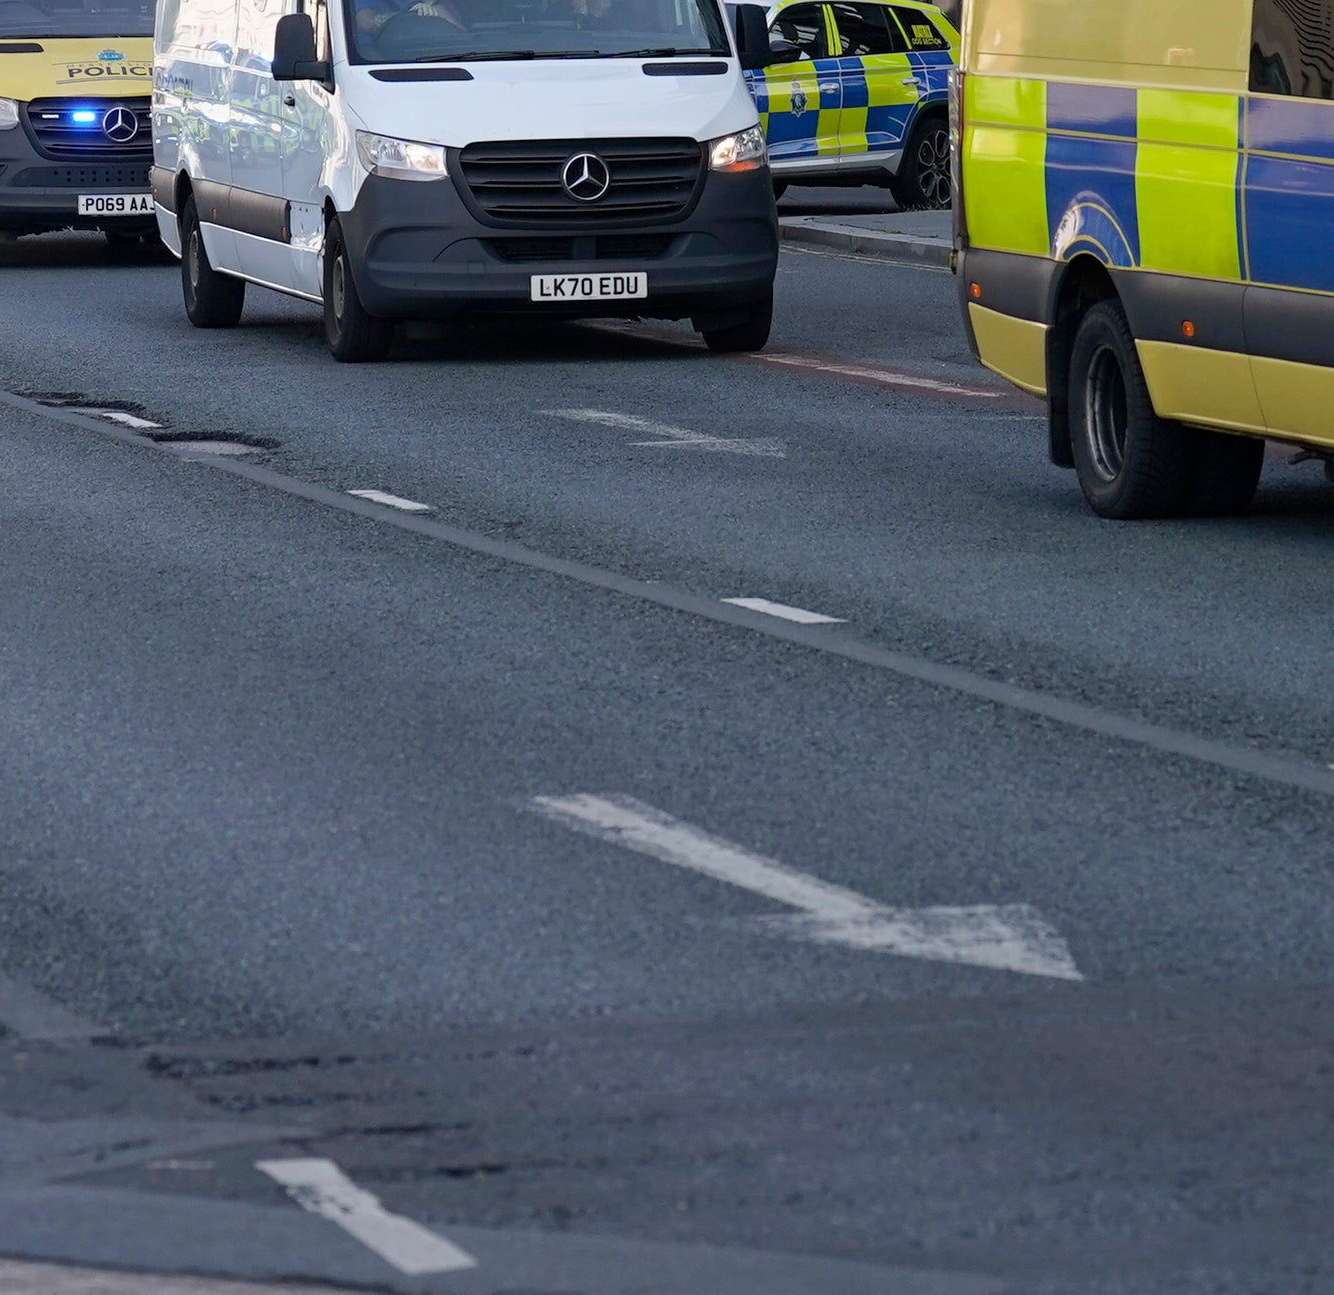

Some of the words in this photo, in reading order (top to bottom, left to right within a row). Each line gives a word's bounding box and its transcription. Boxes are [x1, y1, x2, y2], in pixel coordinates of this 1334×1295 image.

[85, 197, 125, 212] PO69
[540, 277, 594, 297] LK70
[599, 276, 638, 296] EDU
